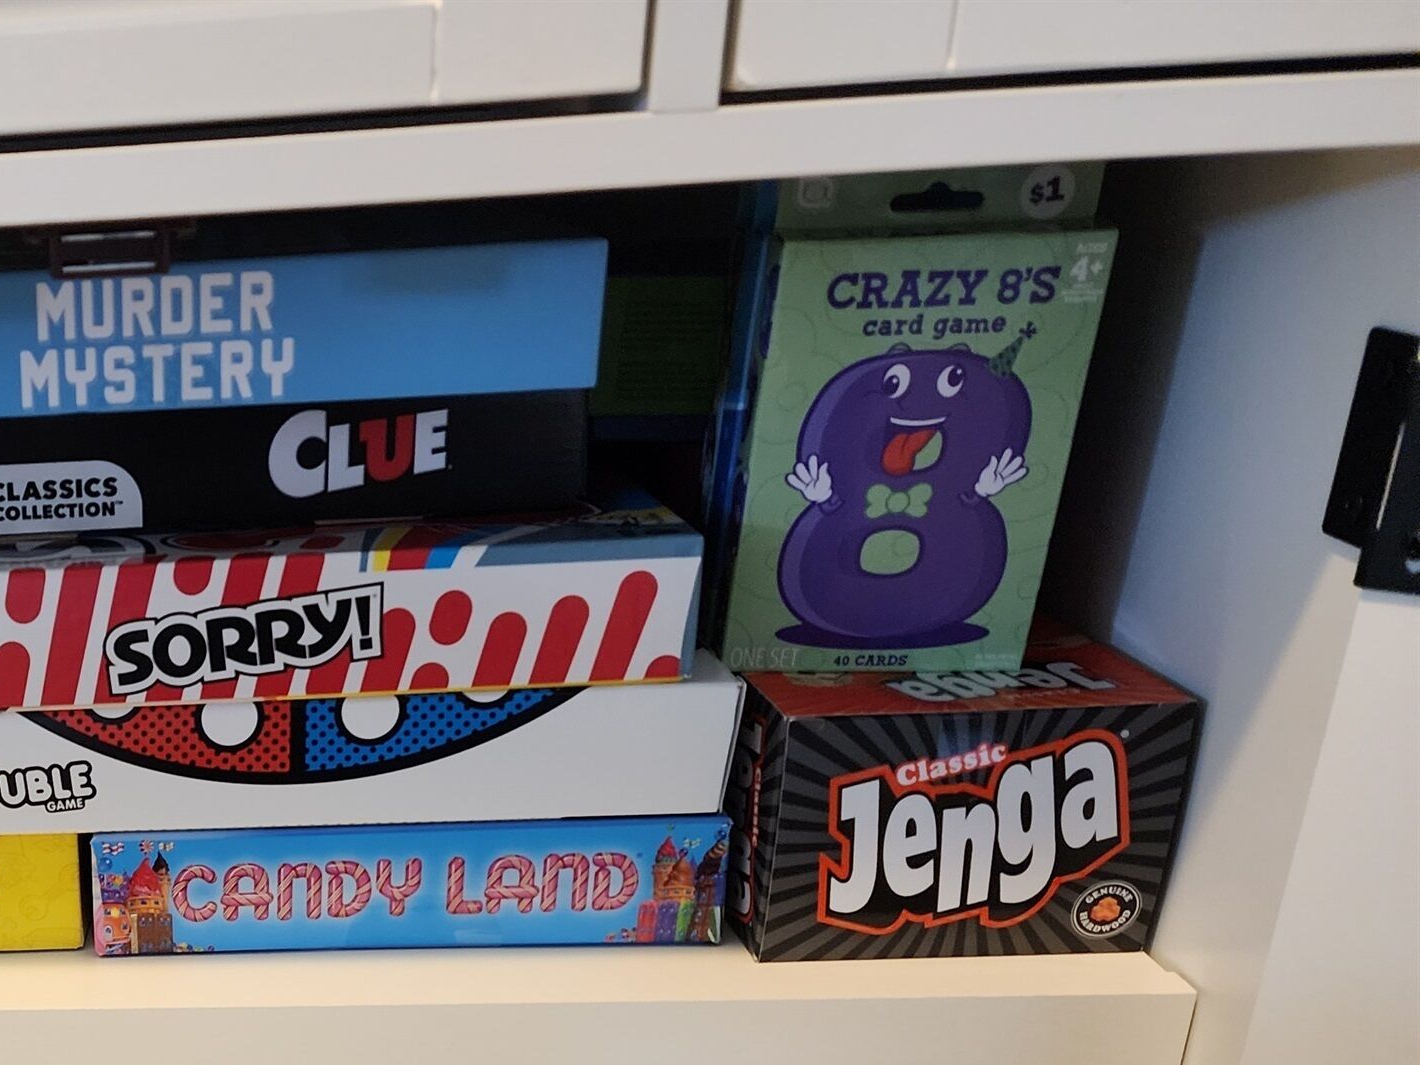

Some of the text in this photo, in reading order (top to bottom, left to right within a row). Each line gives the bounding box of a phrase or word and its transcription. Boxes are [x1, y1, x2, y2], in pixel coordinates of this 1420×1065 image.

[1028, 176, 1065, 206] $1
[34, 270, 276, 343] MURDER
[826, 269, 988, 309] CRAZY
[996, 266, 1063, 305] 8'S
[862, 314, 1007, 340] card game
[19, 336, 296, 411] MYSTERY
[268, 408, 450, 499] CLUE
[109, 588, 378, 693] SORRY!
[730, 647, 801, 668] ONE SET
[833, 654, 909, 667] 40 CARDS
[895, 742, 1008, 787] Classic
[46, 799, 84, 812] GAME
[828, 740, 1119, 914] Jenga
[172, 851, 640, 922] CANDY LAND
[1084, 886, 1134, 905] GENUINE
[1078, 909, 1132, 934] HARDWOOD
